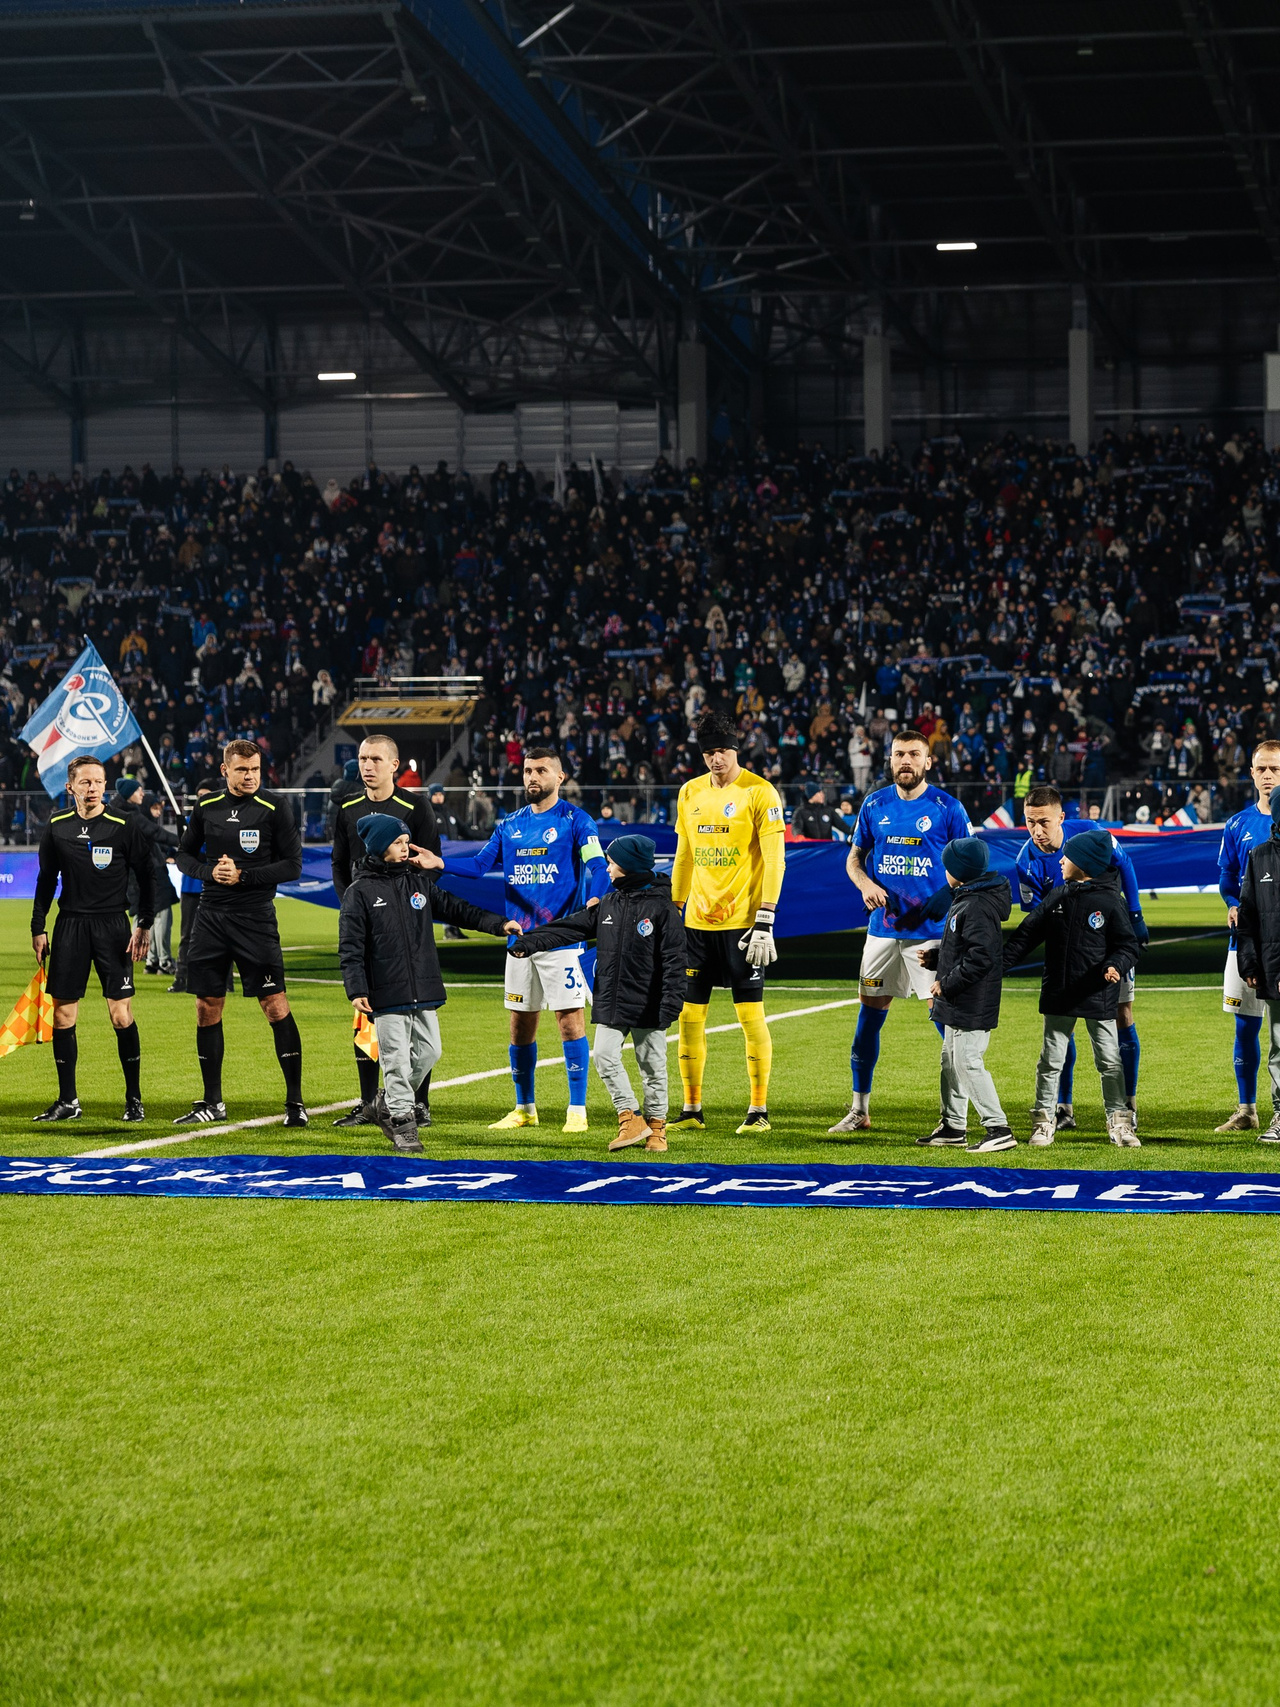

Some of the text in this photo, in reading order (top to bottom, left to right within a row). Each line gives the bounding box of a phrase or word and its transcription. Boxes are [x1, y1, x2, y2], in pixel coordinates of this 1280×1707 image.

[694, 847, 741, 857] EKONIVA
[694, 857, 737, 866] КОНИВА
[883, 854, 933, 868] EKONIVA
[513, 863, 559, 875] EKONIVA
[878, 864, 928, 877] ЭКОНИВА
[508, 873, 555, 885] ЭКОНИВА
